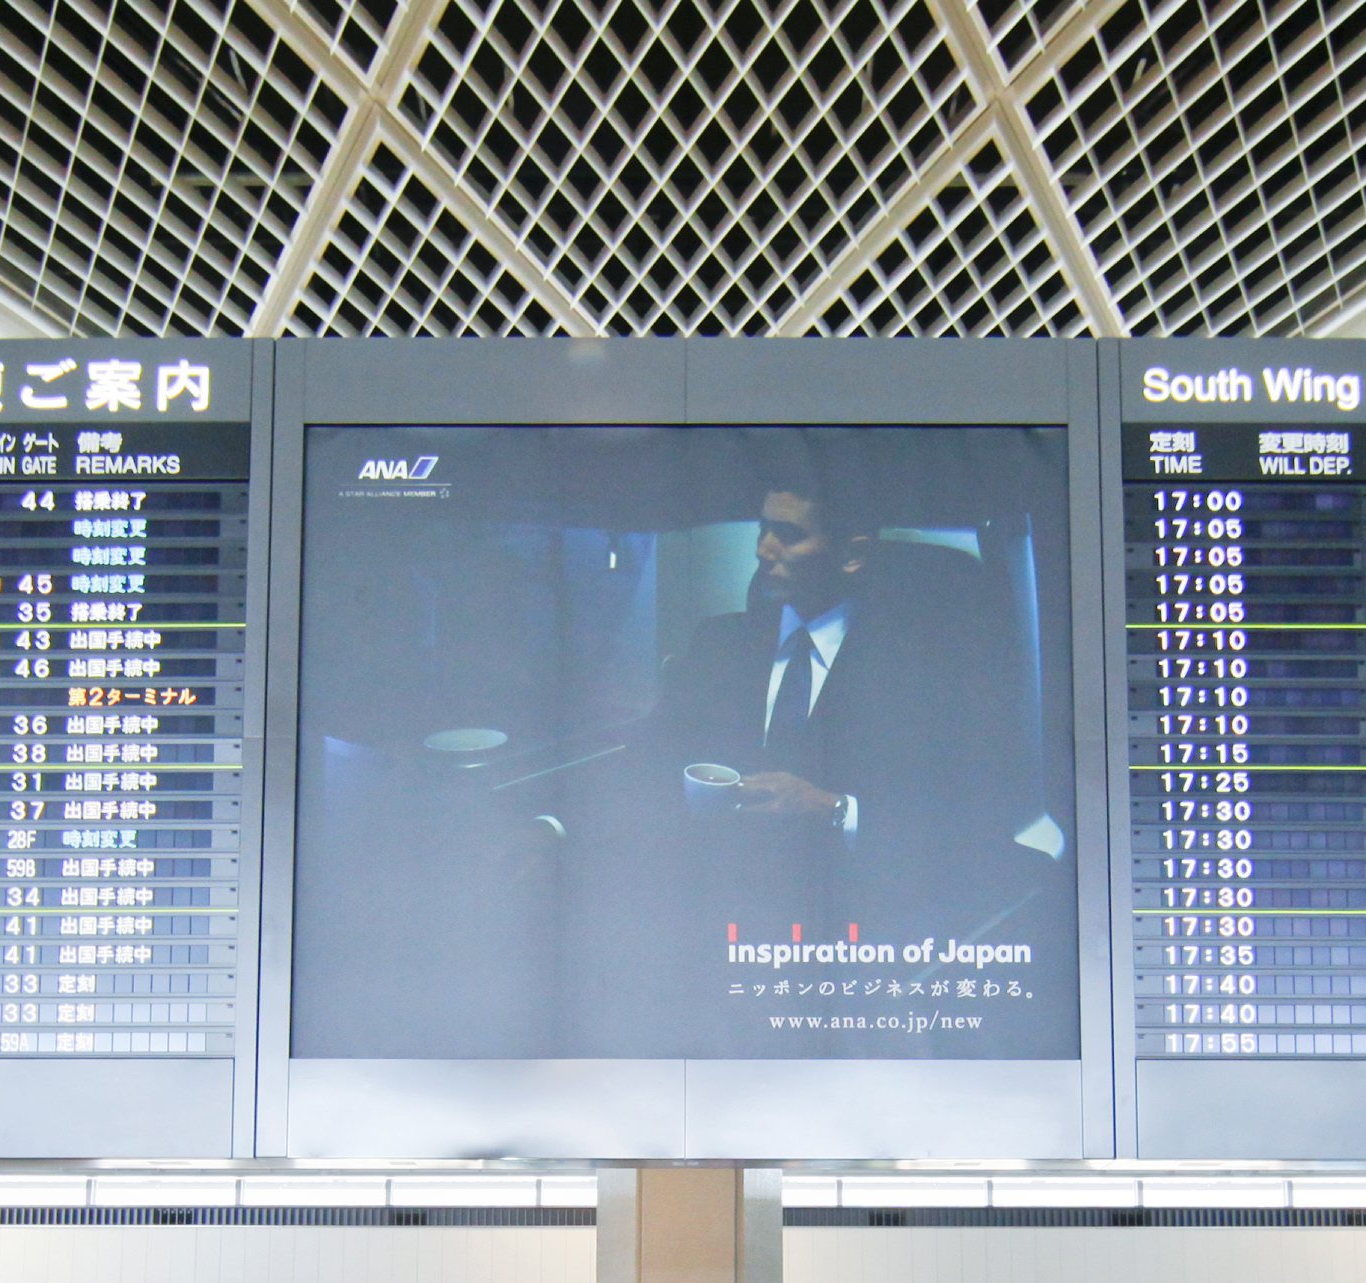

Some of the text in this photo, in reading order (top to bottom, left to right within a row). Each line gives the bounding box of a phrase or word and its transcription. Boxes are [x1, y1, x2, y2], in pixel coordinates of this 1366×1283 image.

[1143, 368, 1252, 403] South
[1263, 369, 1359, 410] Wing
[1149, 432, 1195, 453] 定刻
[0, 457, 15, 475] IN
[22, 456, 57, 474] GATE
[76, 455, 180, 474] REMARKS
[358, 460, 408, 479] ANA
[1150, 456, 1202, 474] TIME
[1259, 456, 1352, 475] WILL DEP.
[22, 492, 55, 512] 44
[1154, 492, 1243, 512] 17:00
[1155, 520, 1243, 540] 17:05
[18, 603, 52, 622] 35
[15, 632, 52, 650] 43
[1159, 632, 1246, 652] 17:10
[1159, 687, 1248, 707] 17:10
[12, 744, 47, 763] 38
[1161, 772, 1249, 792] 17:25
[1163, 859, 1252, 879] 17:30
[727, 923, 1032, 969] inspiration of Japan
[729, 979, 1033, 999] ニッポンのビジネスが変わる。
[1166, 975, 1256, 995] 17:40
[770, 1010, 983, 1033] www.ana.co.jp/new
